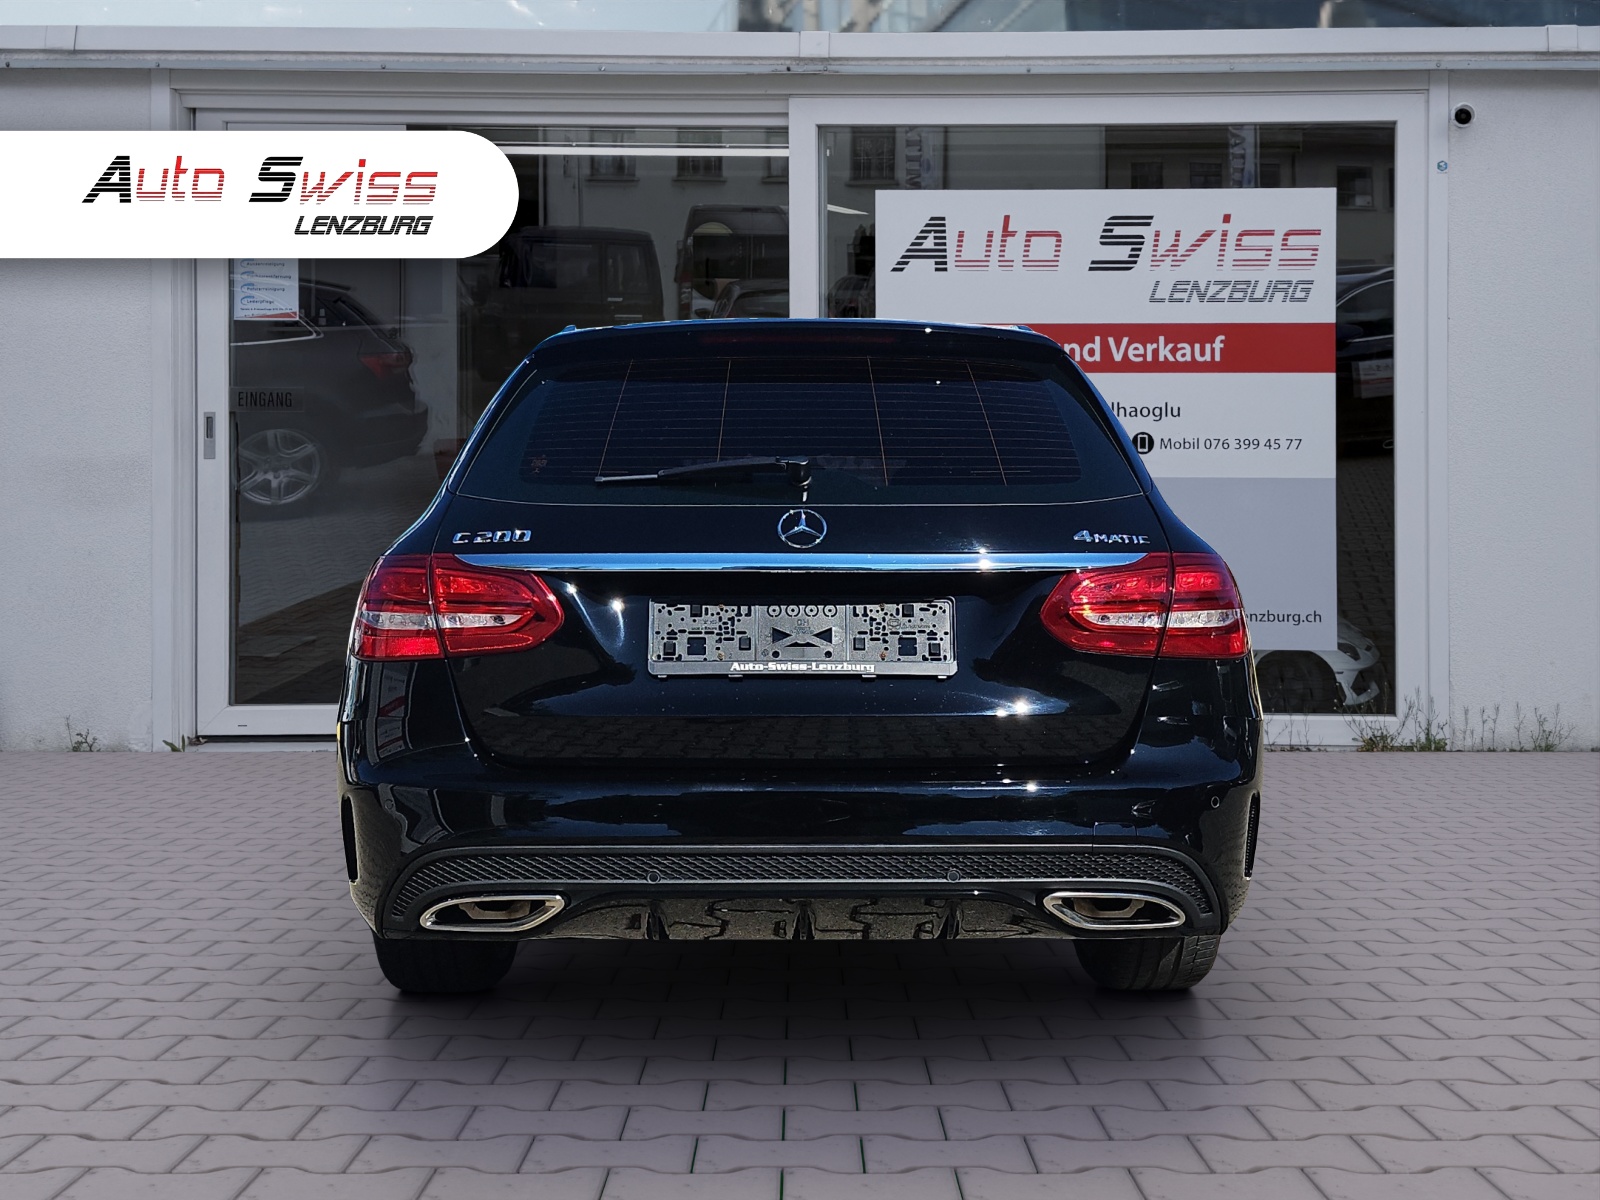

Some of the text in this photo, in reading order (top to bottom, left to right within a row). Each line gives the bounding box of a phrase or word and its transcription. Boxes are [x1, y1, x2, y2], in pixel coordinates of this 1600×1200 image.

[890, 213, 1322, 272] Auto Swiss
[1149, 280, 1315, 303] LENZBURG
[1107, 335, 1225, 362] Verkauf
[238, 391, 292, 408] EINGANG
[1159, 437, 1302, 450] Mobil 076 399 45 77
[1073, 529, 1150, 544] 4MATIC
